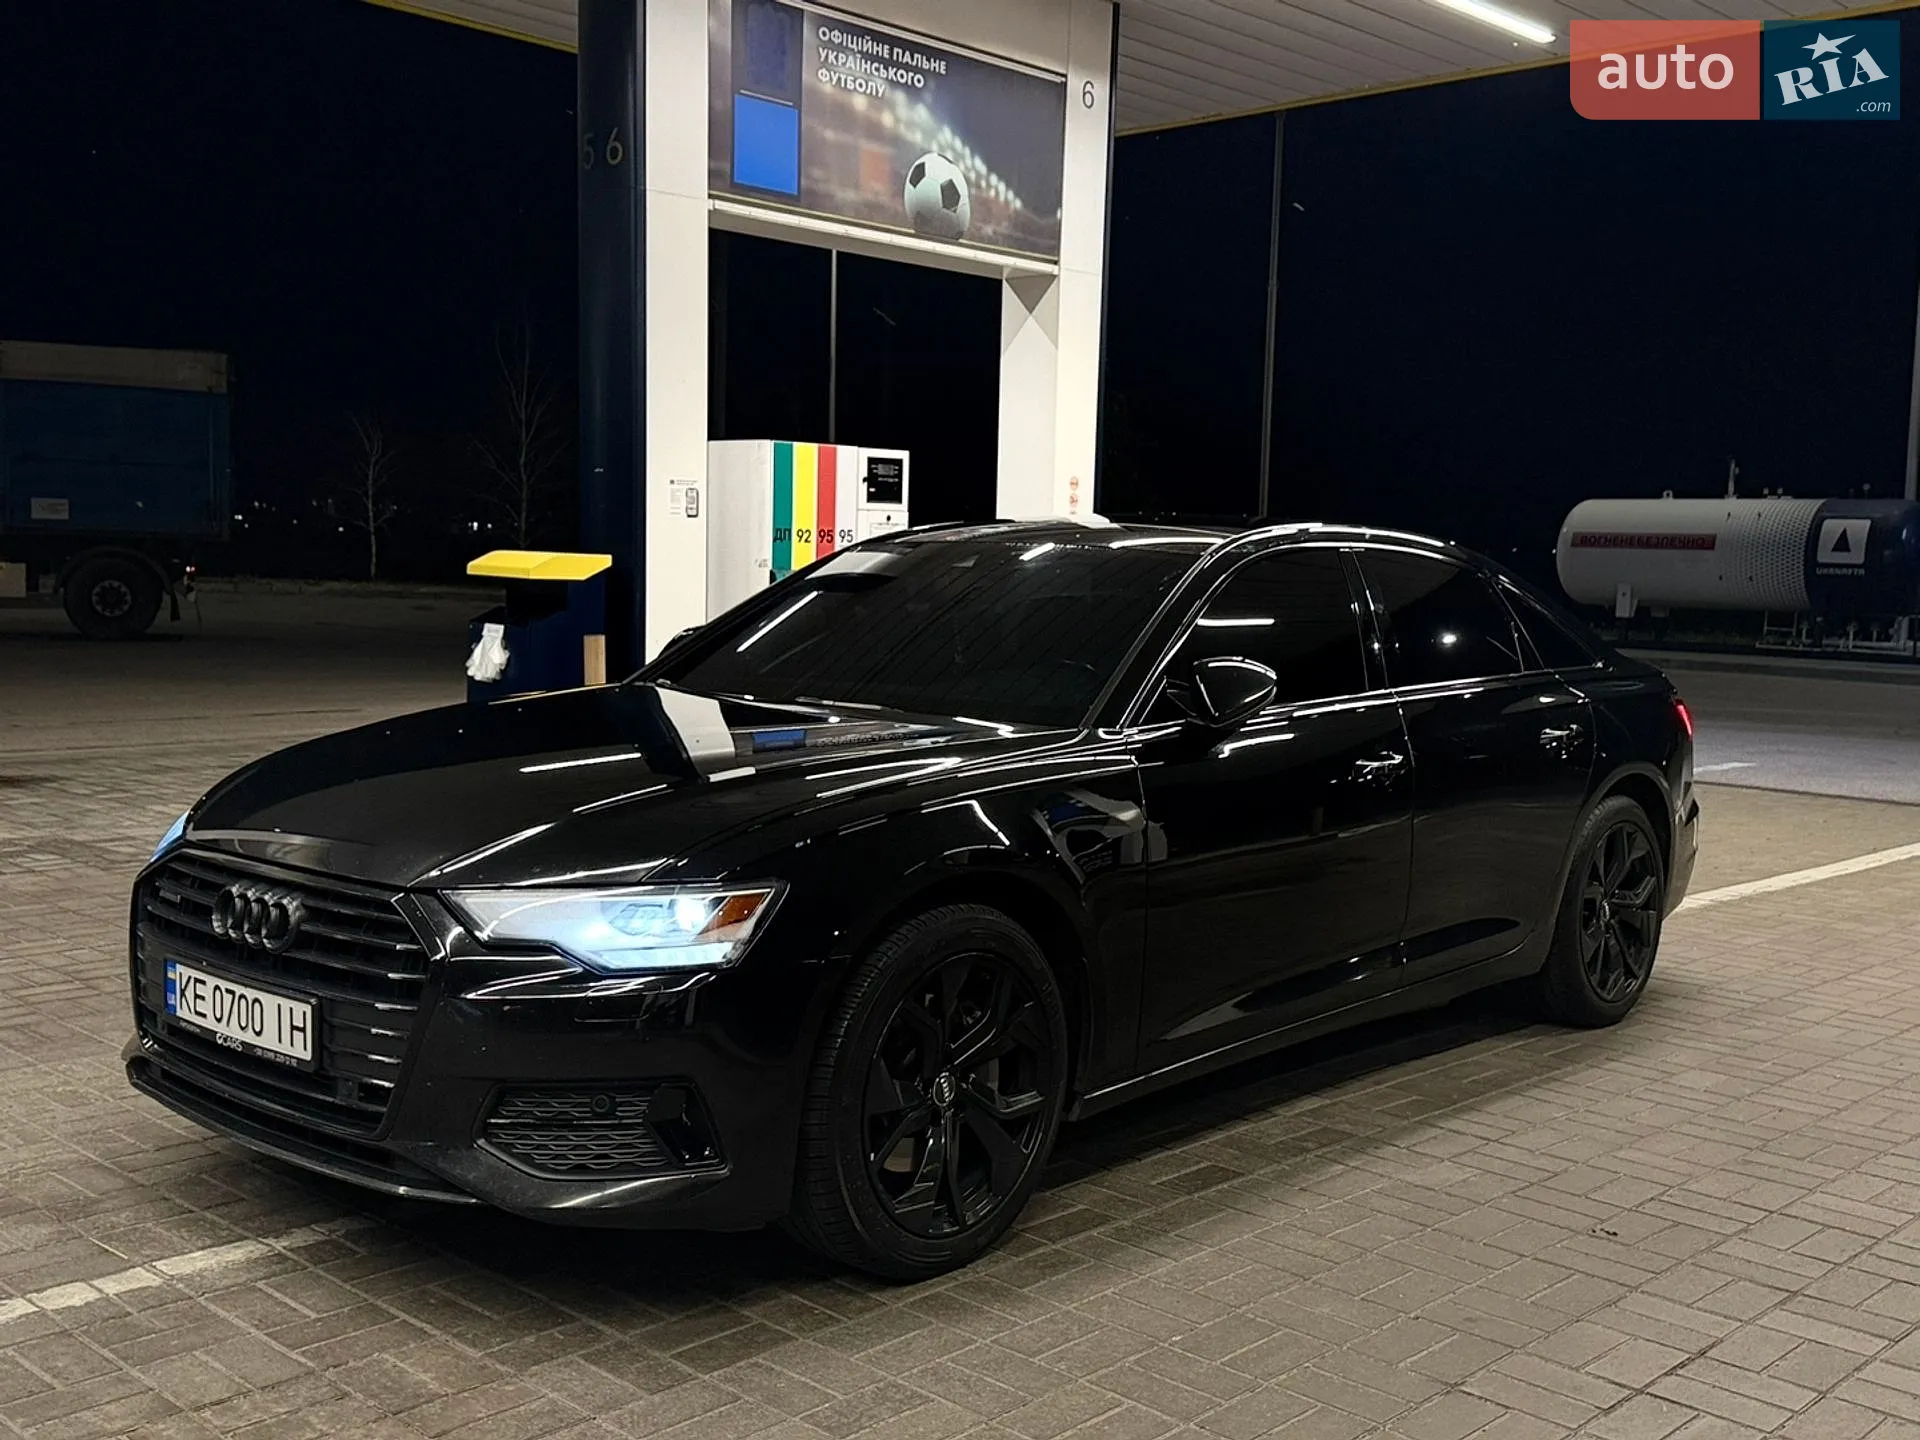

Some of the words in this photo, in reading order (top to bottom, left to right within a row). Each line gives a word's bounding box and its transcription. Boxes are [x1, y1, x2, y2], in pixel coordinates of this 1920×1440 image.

[818, 26, 890, 58] ОФІЦІЙНЕ
[892, 48, 947, 75] ПАЛЬНЕ
[818, 48, 925, 89] УКРАЇНСЬКОГО
[817, 69, 886, 98] ФУТБОЛУ
[1081, 80, 1095, 109] 6
[606, 126, 624, 166] 6
[773, 529, 792, 543] ДП
[796, 528, 812, 544] 92
[818, 529, 834, 544] 95
[838, 529, 854, 544] 95
[179, 971, 207, 1020] KE
[213, 984, 264, 1037] 0700
[277, 1002, 308, 1052] IH
